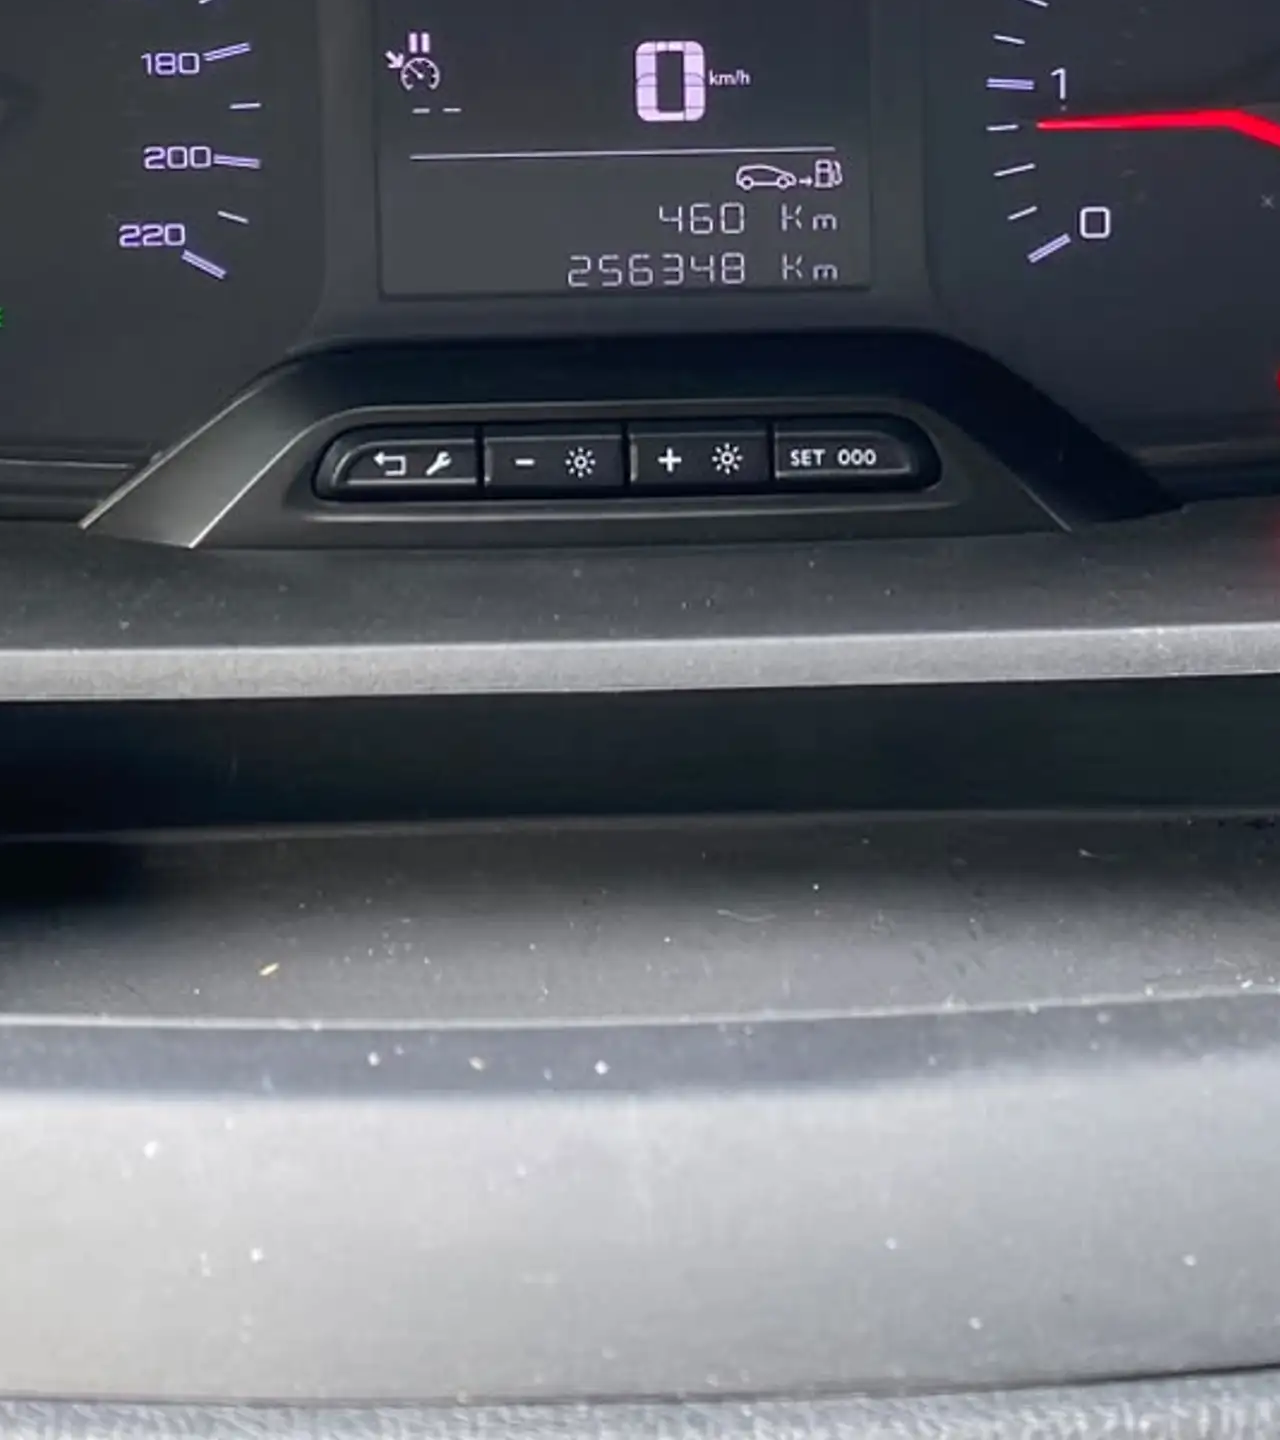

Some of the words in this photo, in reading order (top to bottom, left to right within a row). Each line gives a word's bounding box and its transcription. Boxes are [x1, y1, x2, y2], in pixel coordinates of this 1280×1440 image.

[141, 52, 200, 75] 180
[634, 40, 706, 122] 0
[708, 69, 751, 87] km/h
[1050, 67, 1067, 101] 1
[144, 146, 212, 169] 200
[119, 223, 186, 247] 220
[658, 202, 745, 235] 460
[781, 203, 838, 231] Km
[1079, 206, 1111, 239] 0
[567, 252, 746, 288] 256348
[781, 253, 839, 281] Km
[790, 447, 827, 467] SET
